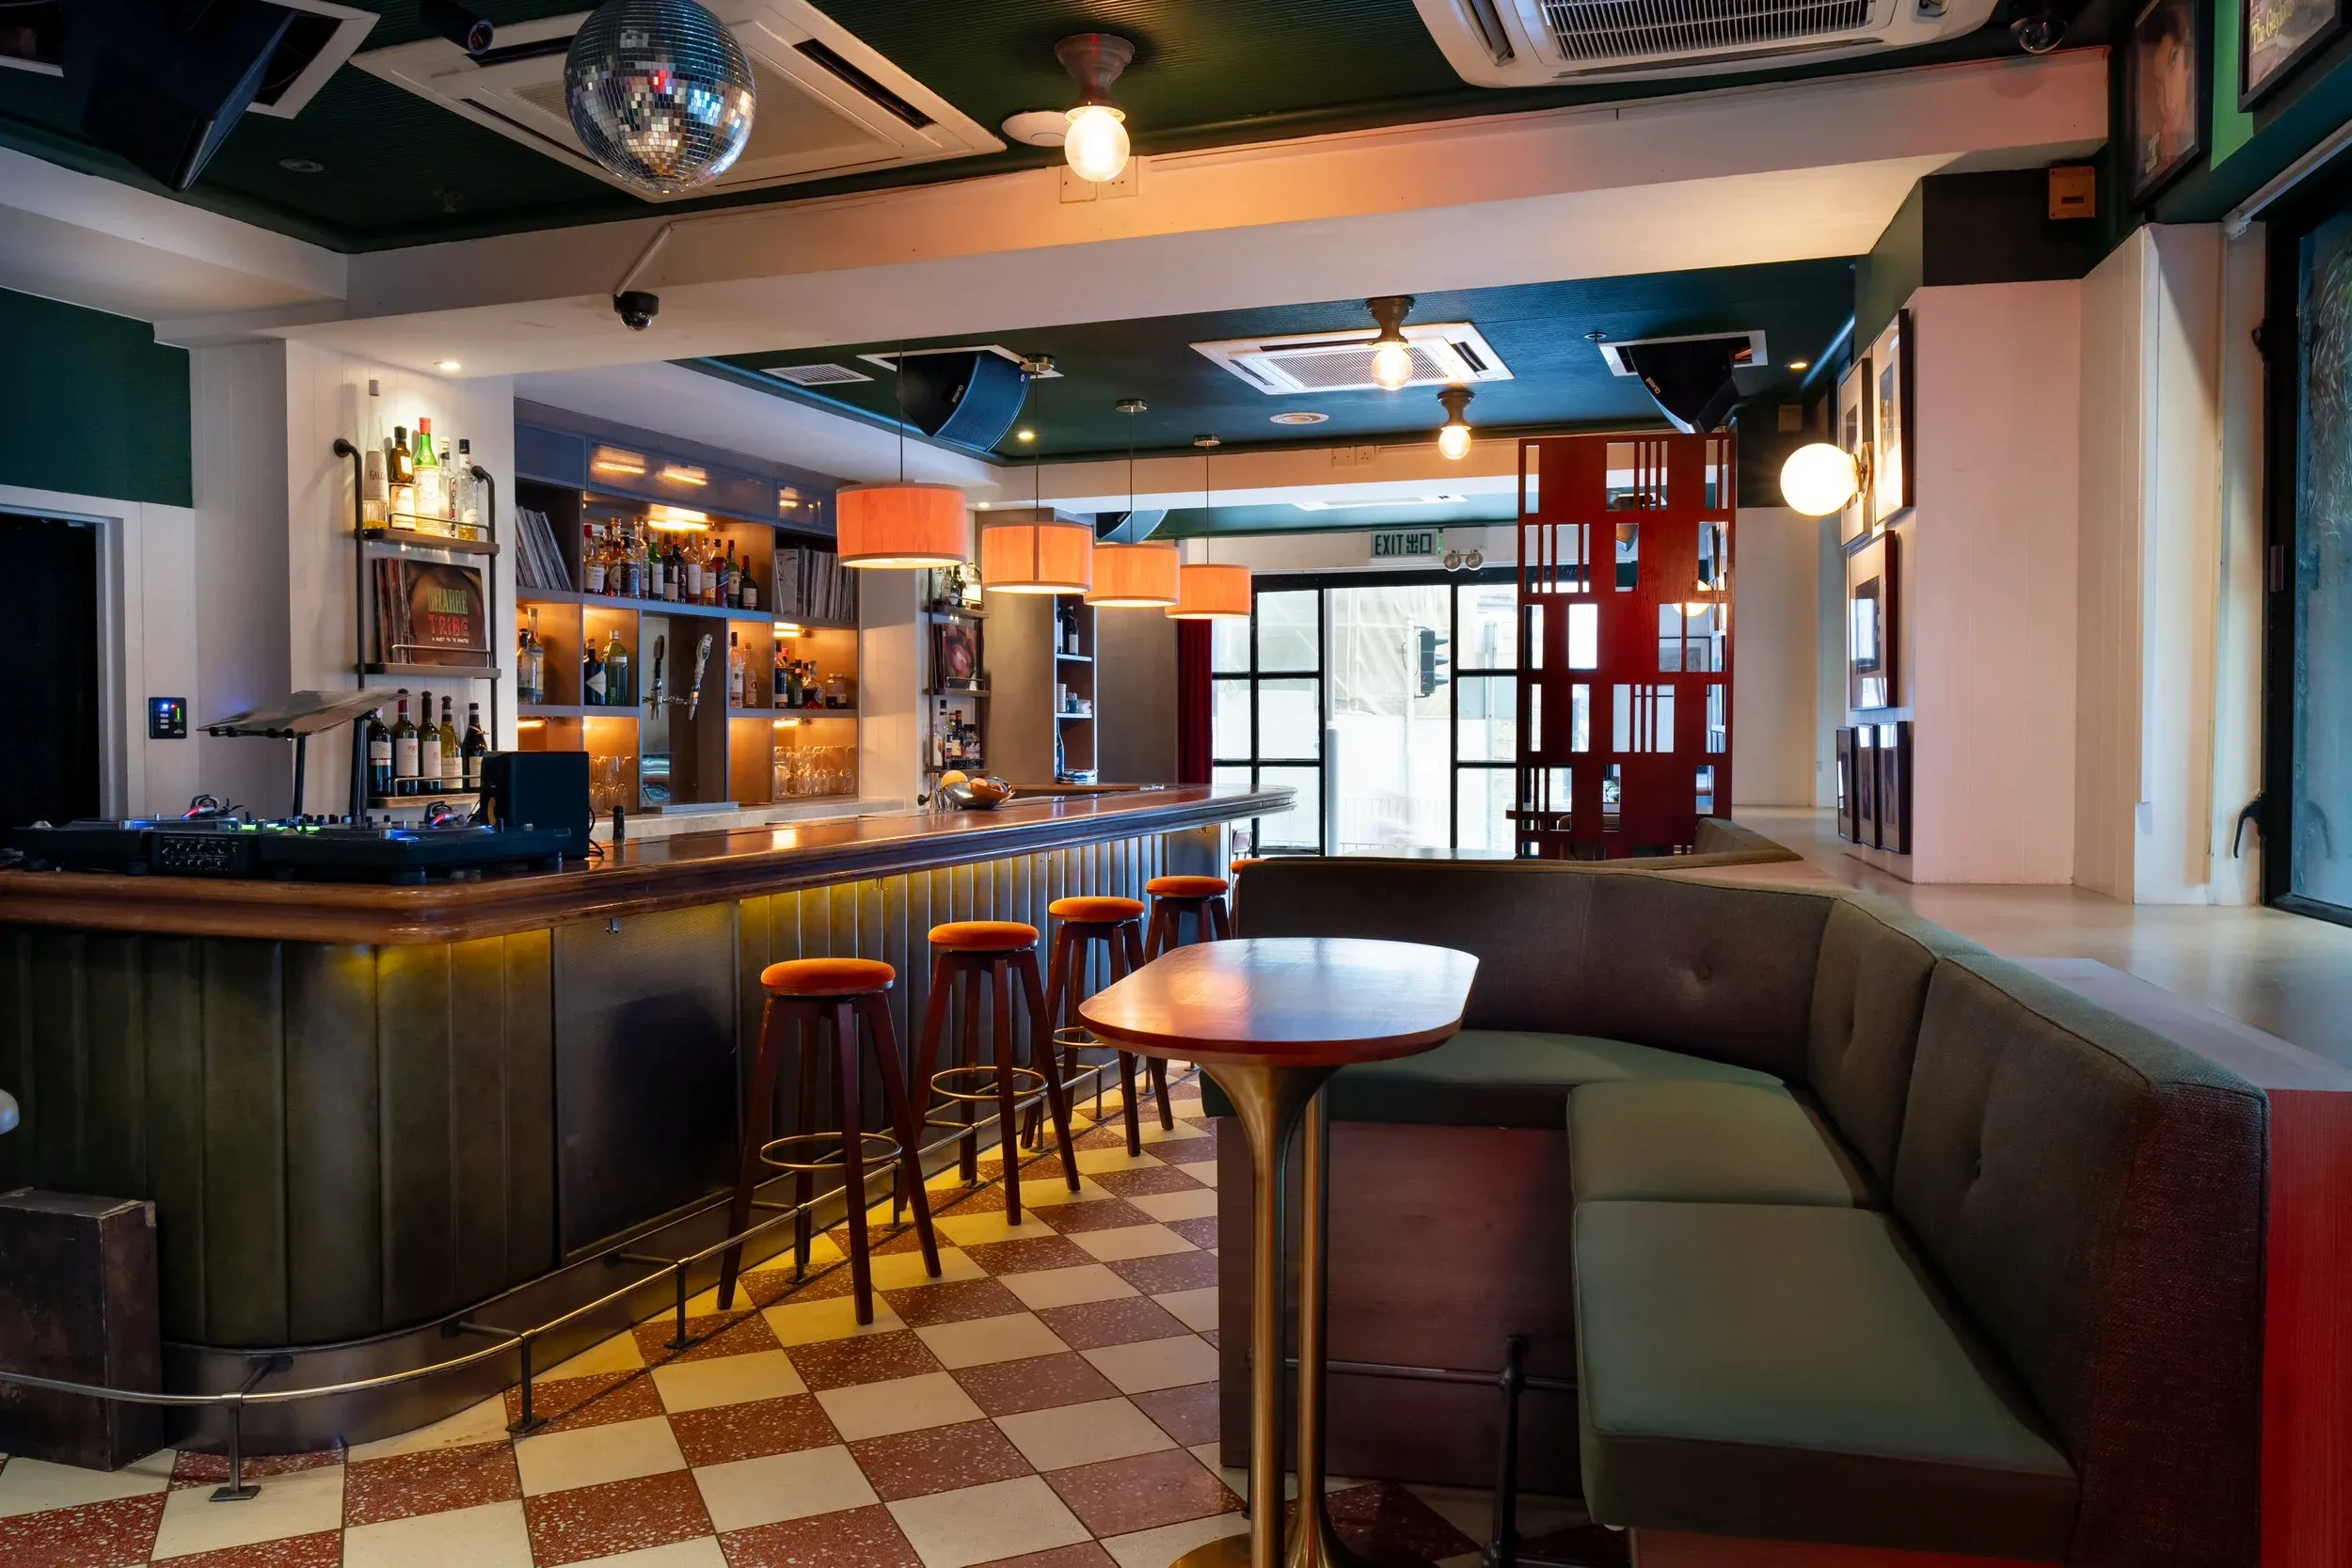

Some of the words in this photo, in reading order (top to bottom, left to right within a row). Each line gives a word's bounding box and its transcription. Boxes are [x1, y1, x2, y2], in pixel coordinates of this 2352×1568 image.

[1375, 534, 1404, 555] EXIT
[1406, 533, 1432, 554] 出口
[428, 588, 469, 615] BIZARRE
[428, 614, 469, 636] TRIBE
